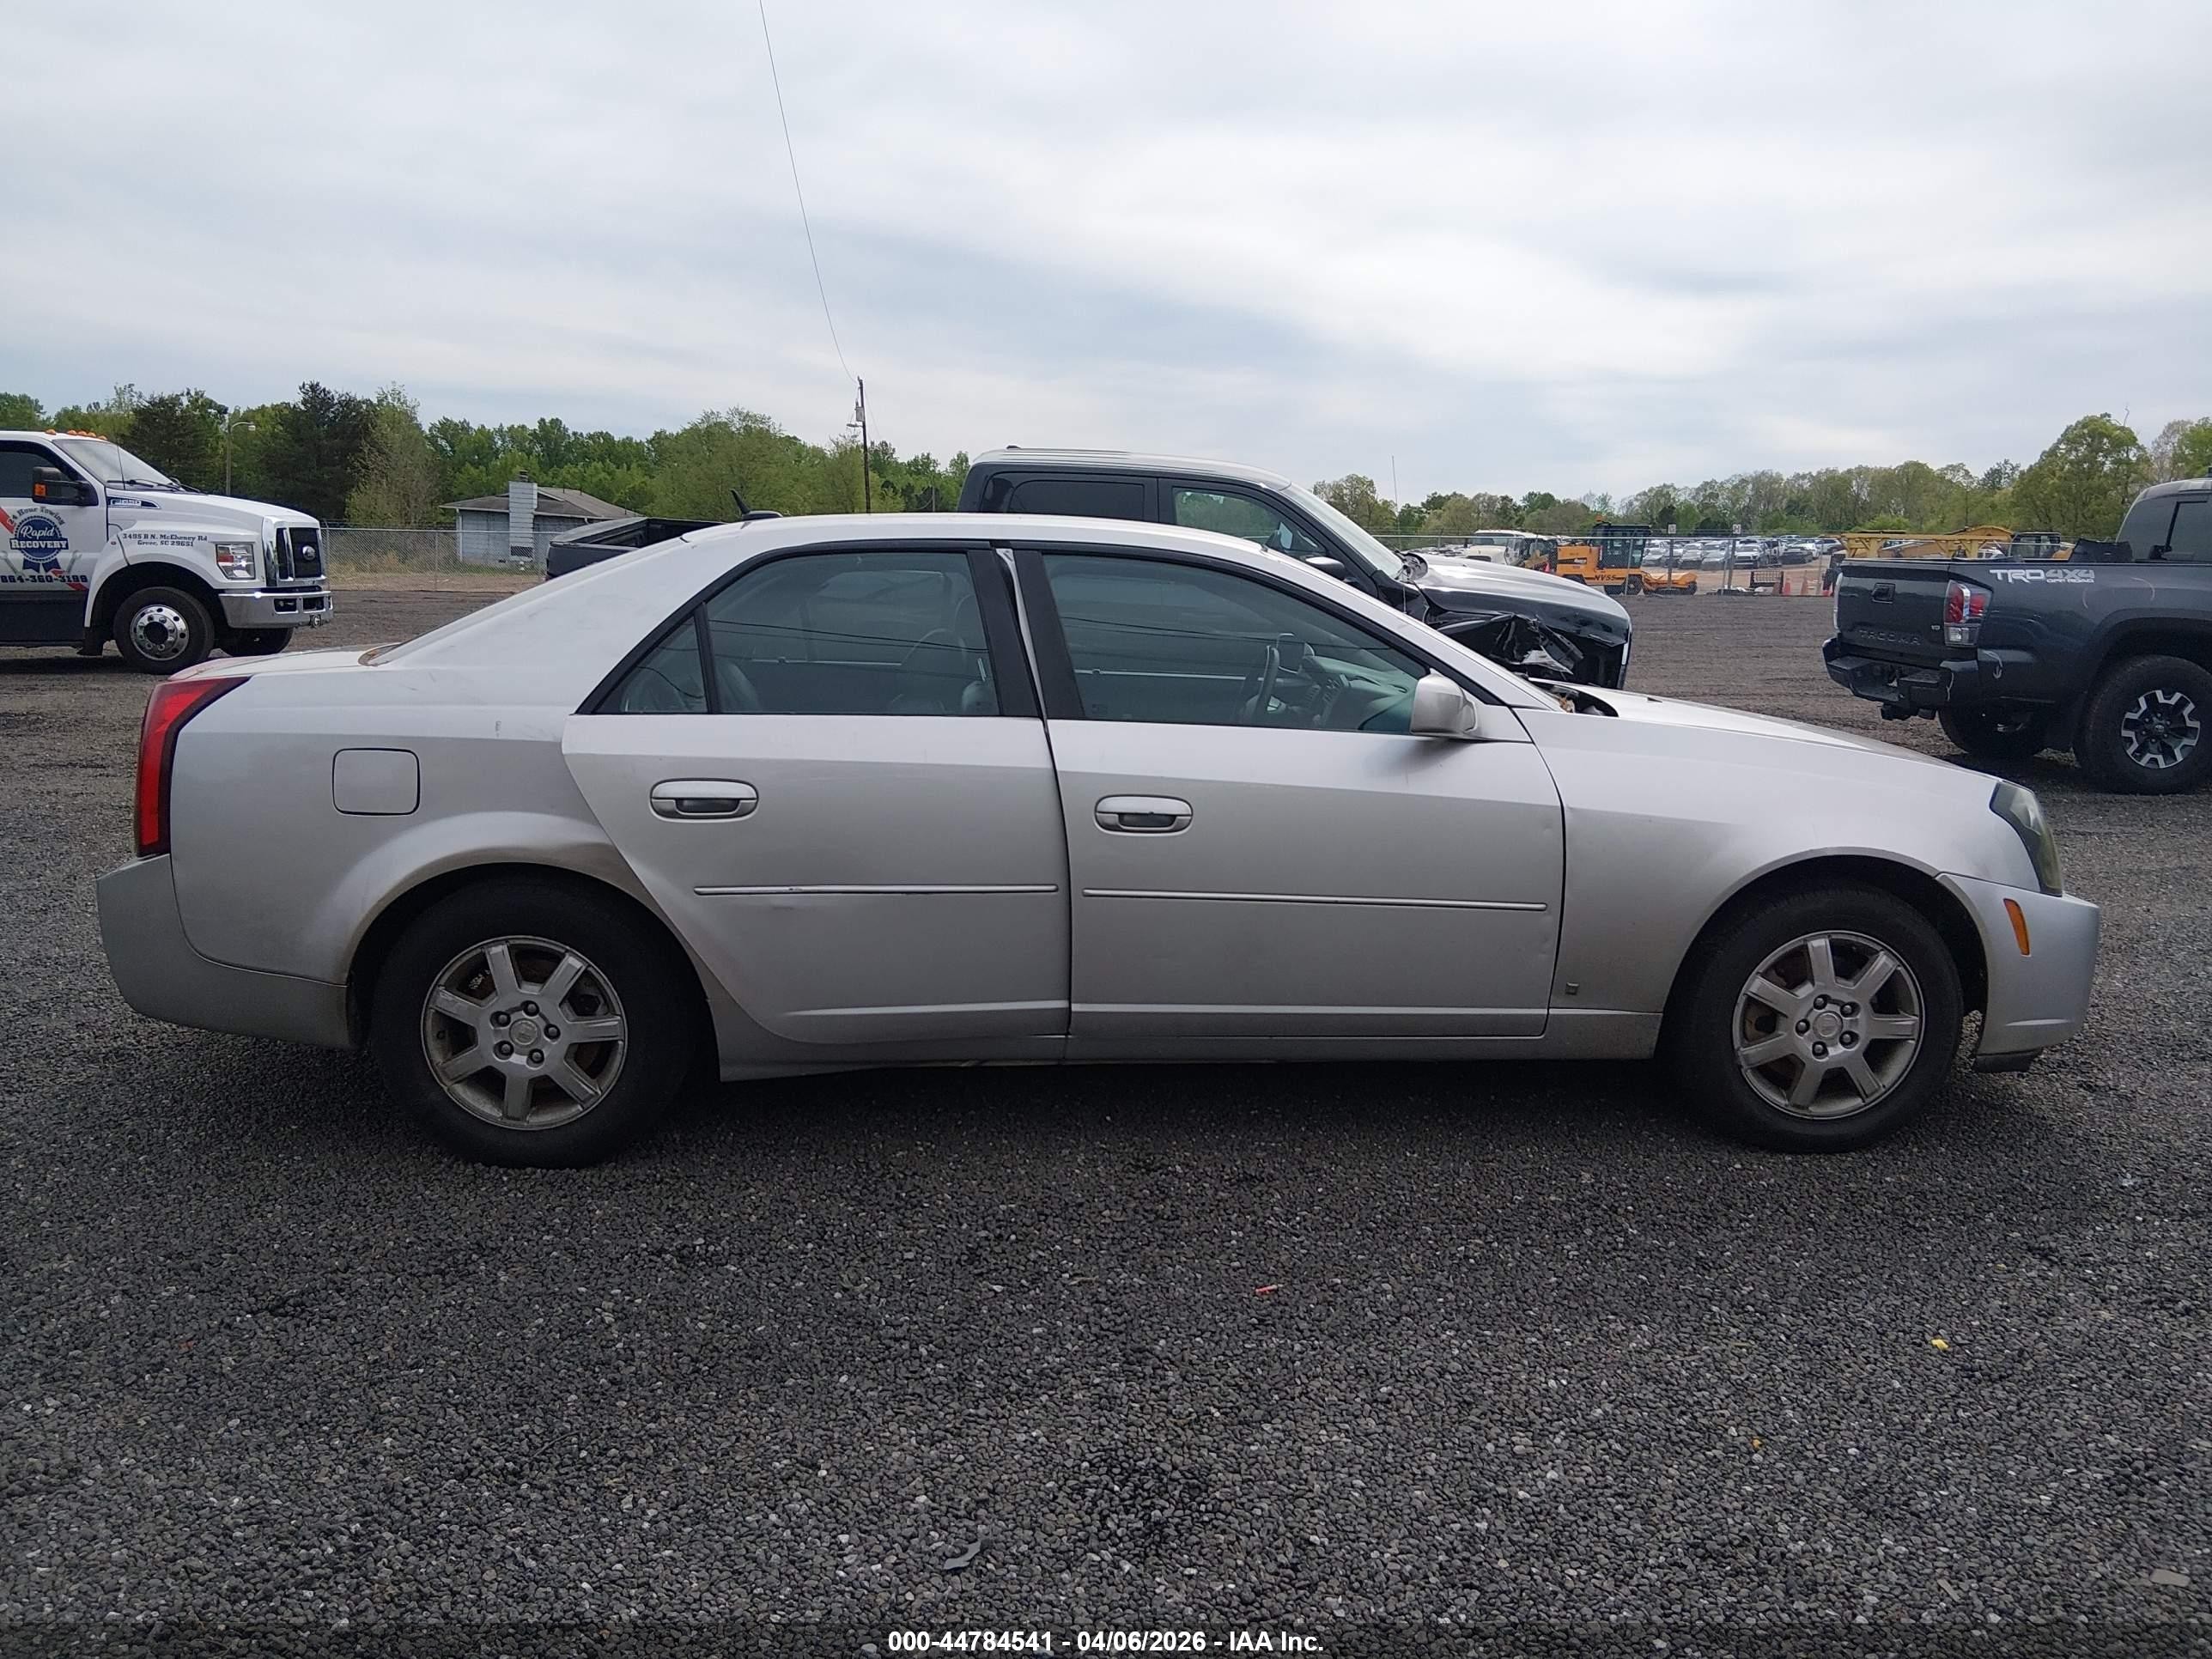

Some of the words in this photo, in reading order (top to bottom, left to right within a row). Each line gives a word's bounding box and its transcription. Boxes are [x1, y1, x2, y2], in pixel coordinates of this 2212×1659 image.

[17, 507, 38, 516] Hour
[40, 507, 65, 526] Towing
[21, 526, 55, 539] Rapid
[1990, 569, 2045, 583] TRD
[1858, 629, 1922, 646] TACOMA
